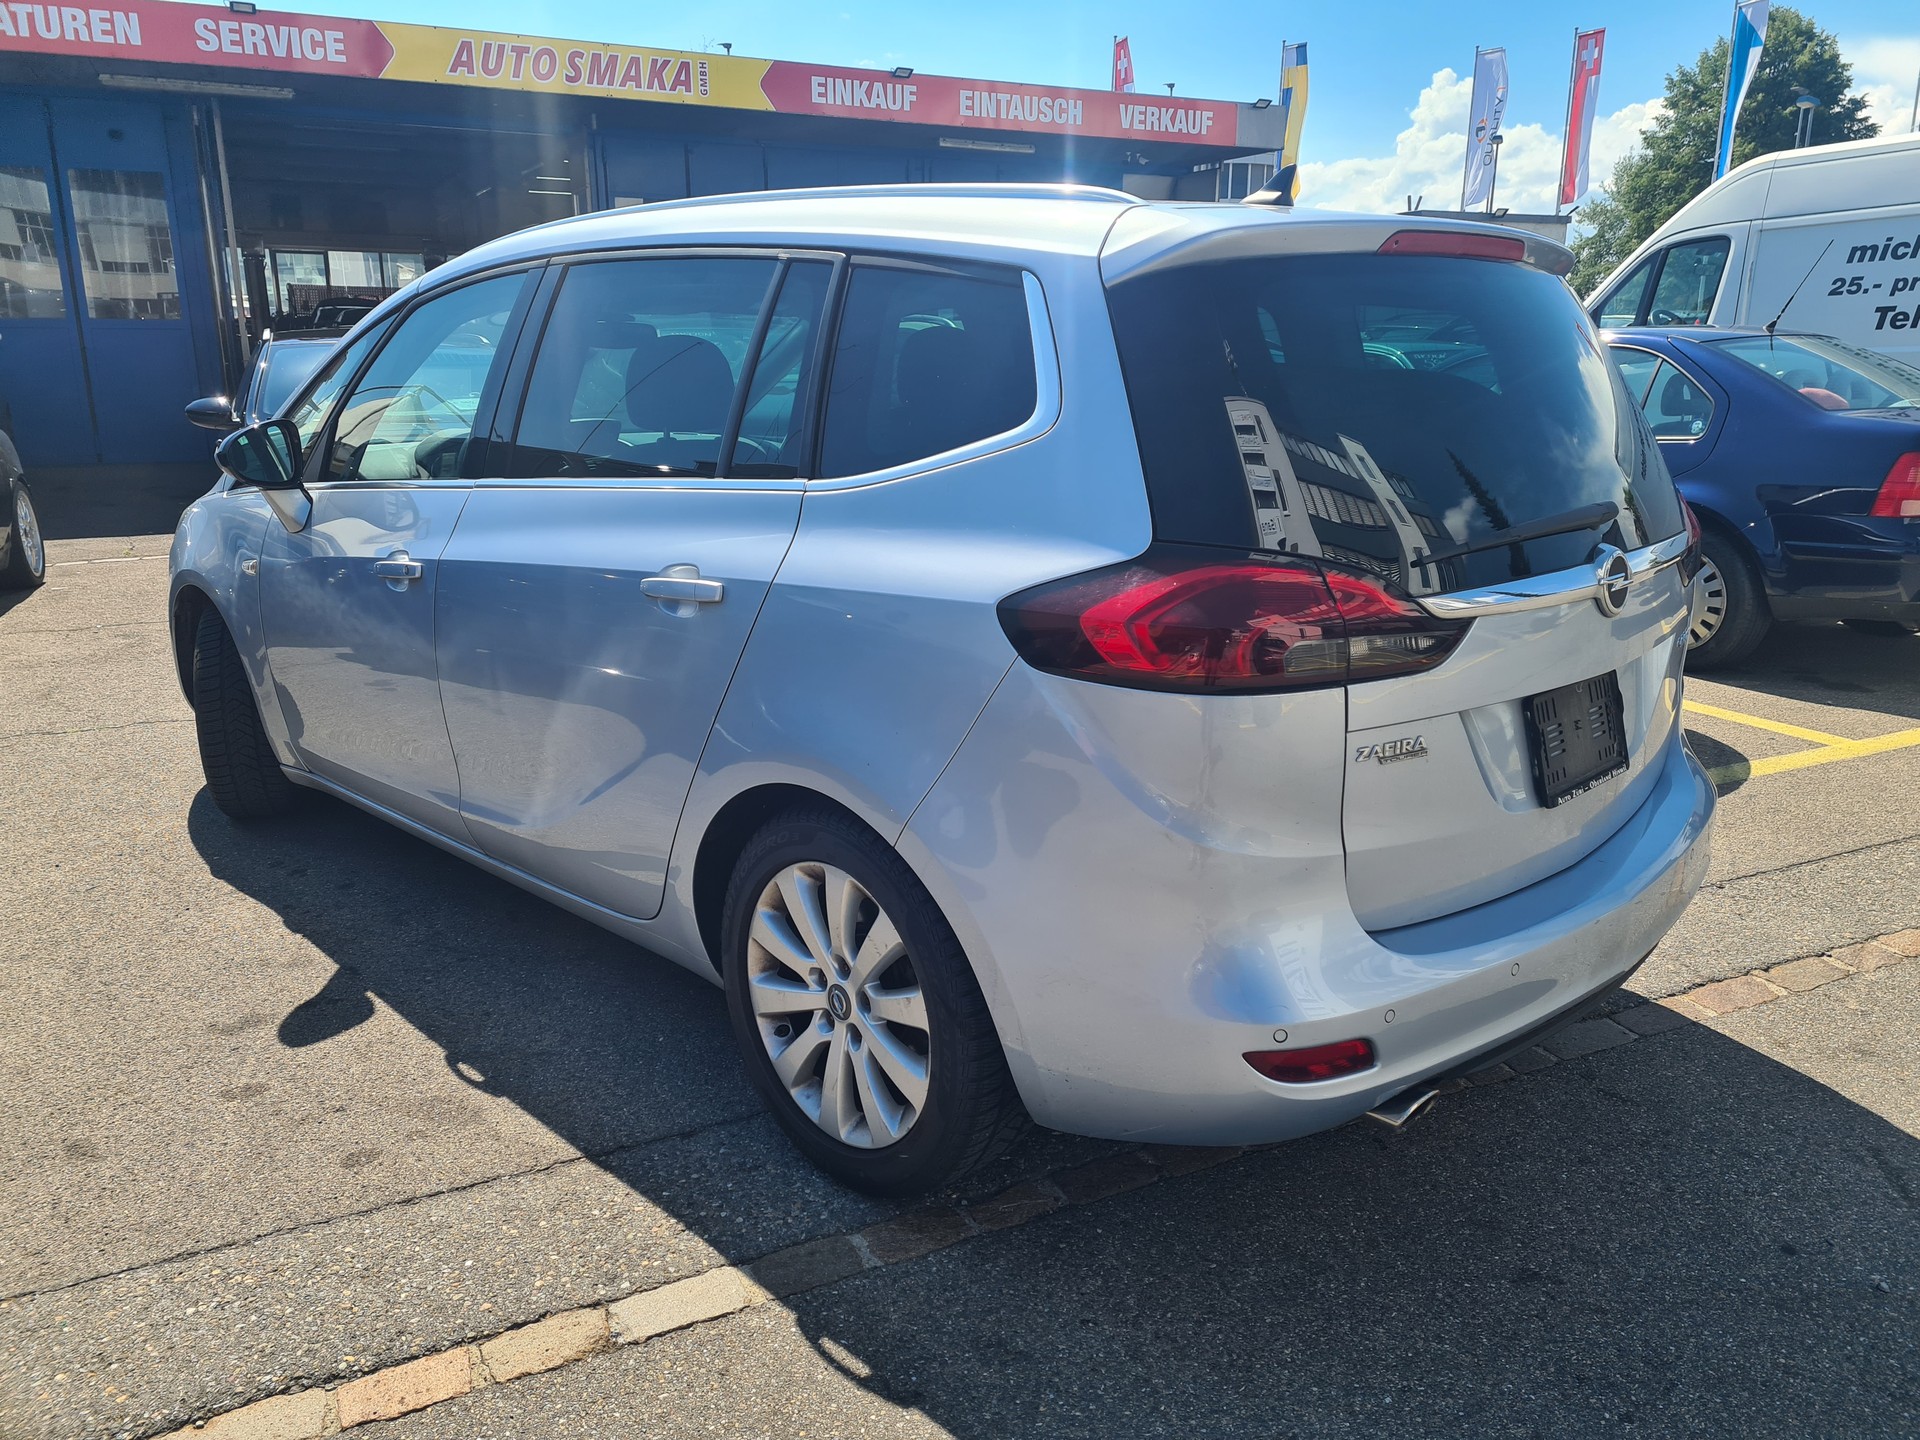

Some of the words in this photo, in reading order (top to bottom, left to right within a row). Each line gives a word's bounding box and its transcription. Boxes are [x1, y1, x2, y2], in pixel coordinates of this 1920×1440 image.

[0, 1, 142, 46] ATUREN
[194, 18, 347, 63] SERVICE
[447, 38, 558, 84] AUTO
[564, 48, 694, 95] SMAKA
[810, 75, 918, 112] EINKAUF
[959, 89, 1083, 126] EINTAUSCH
[1119, 103, 1214, 135] VERKAUF
[1827, 275, 1882, 296] 25.-
[1874, 304, 1920, 330] Tel
[1355, 735, 1427, 762] ZAFIRA
